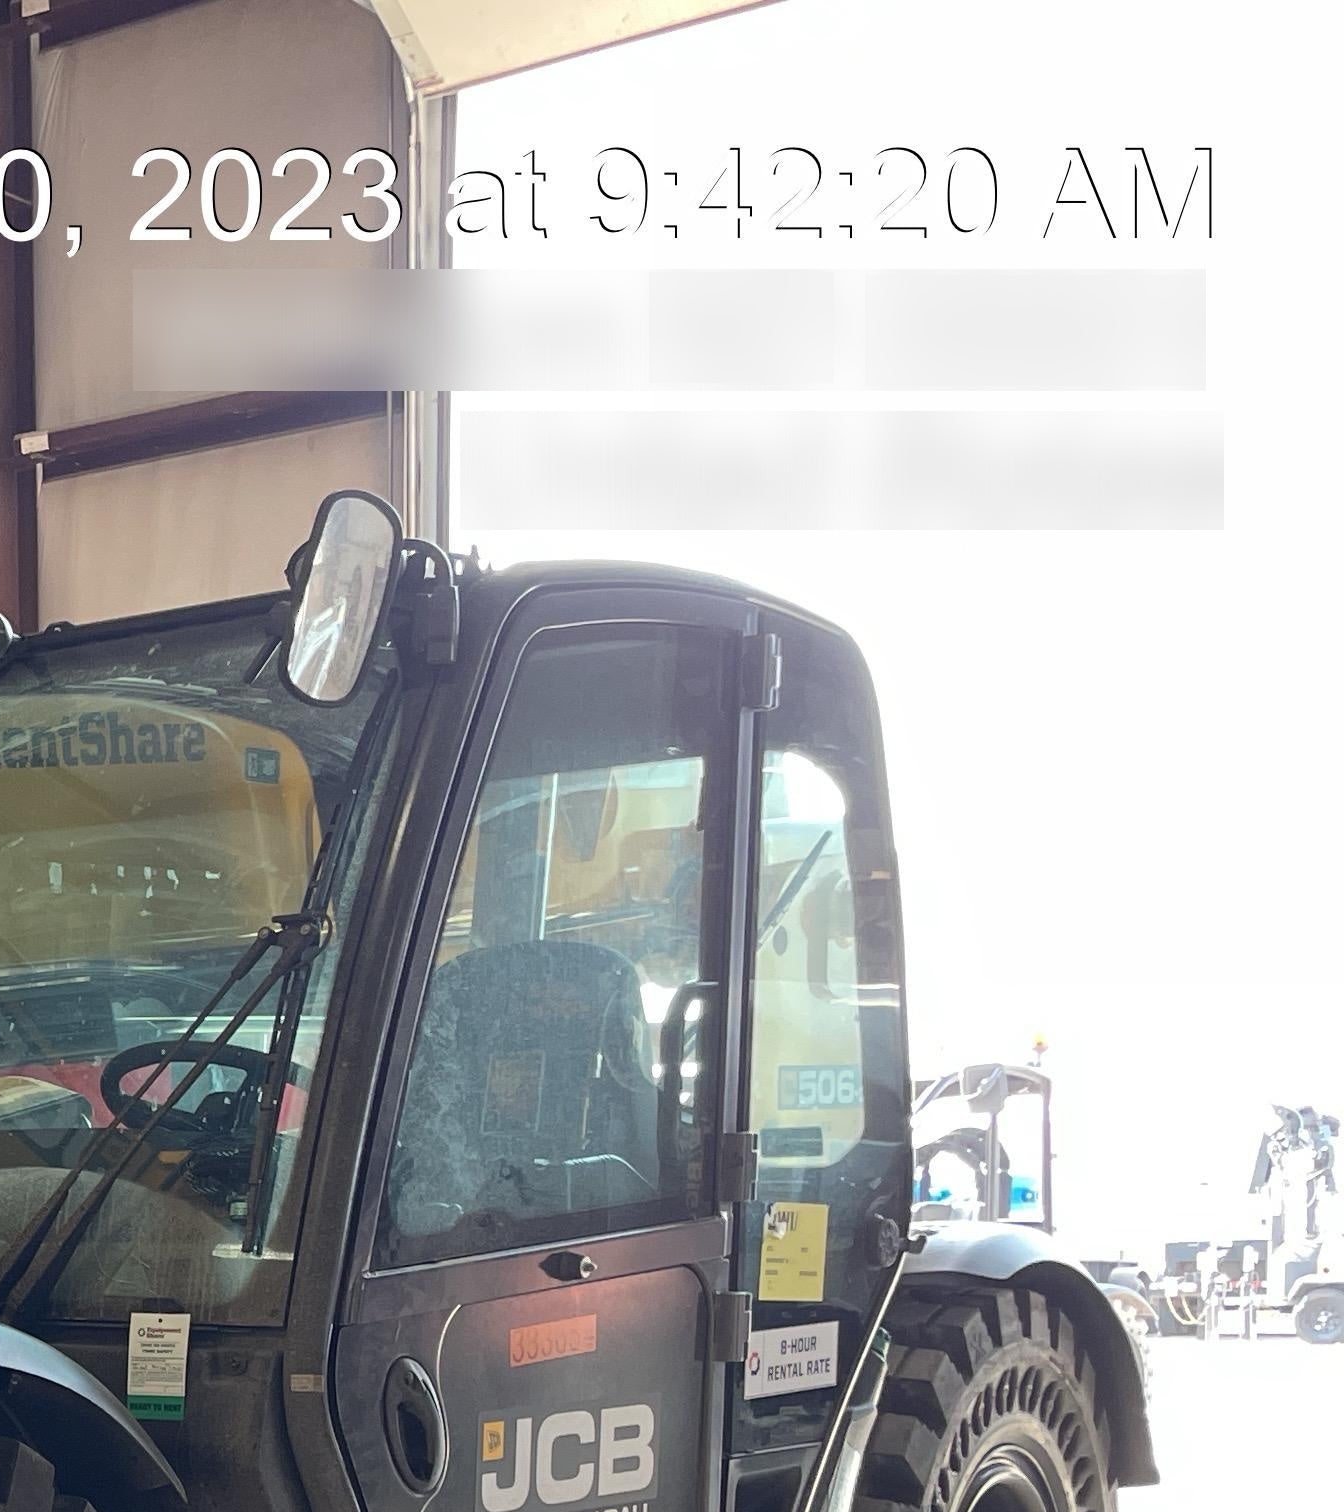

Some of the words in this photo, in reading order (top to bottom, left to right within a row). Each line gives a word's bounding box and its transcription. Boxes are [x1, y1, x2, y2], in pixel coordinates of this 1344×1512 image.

[780, 1335, 817, 1355] 8-HOUR
[767, 1362, 804, 1382] RENTAL
[806, 1358, 831, 1376] RATE
[482, 1404, 655, 1512] JCB
